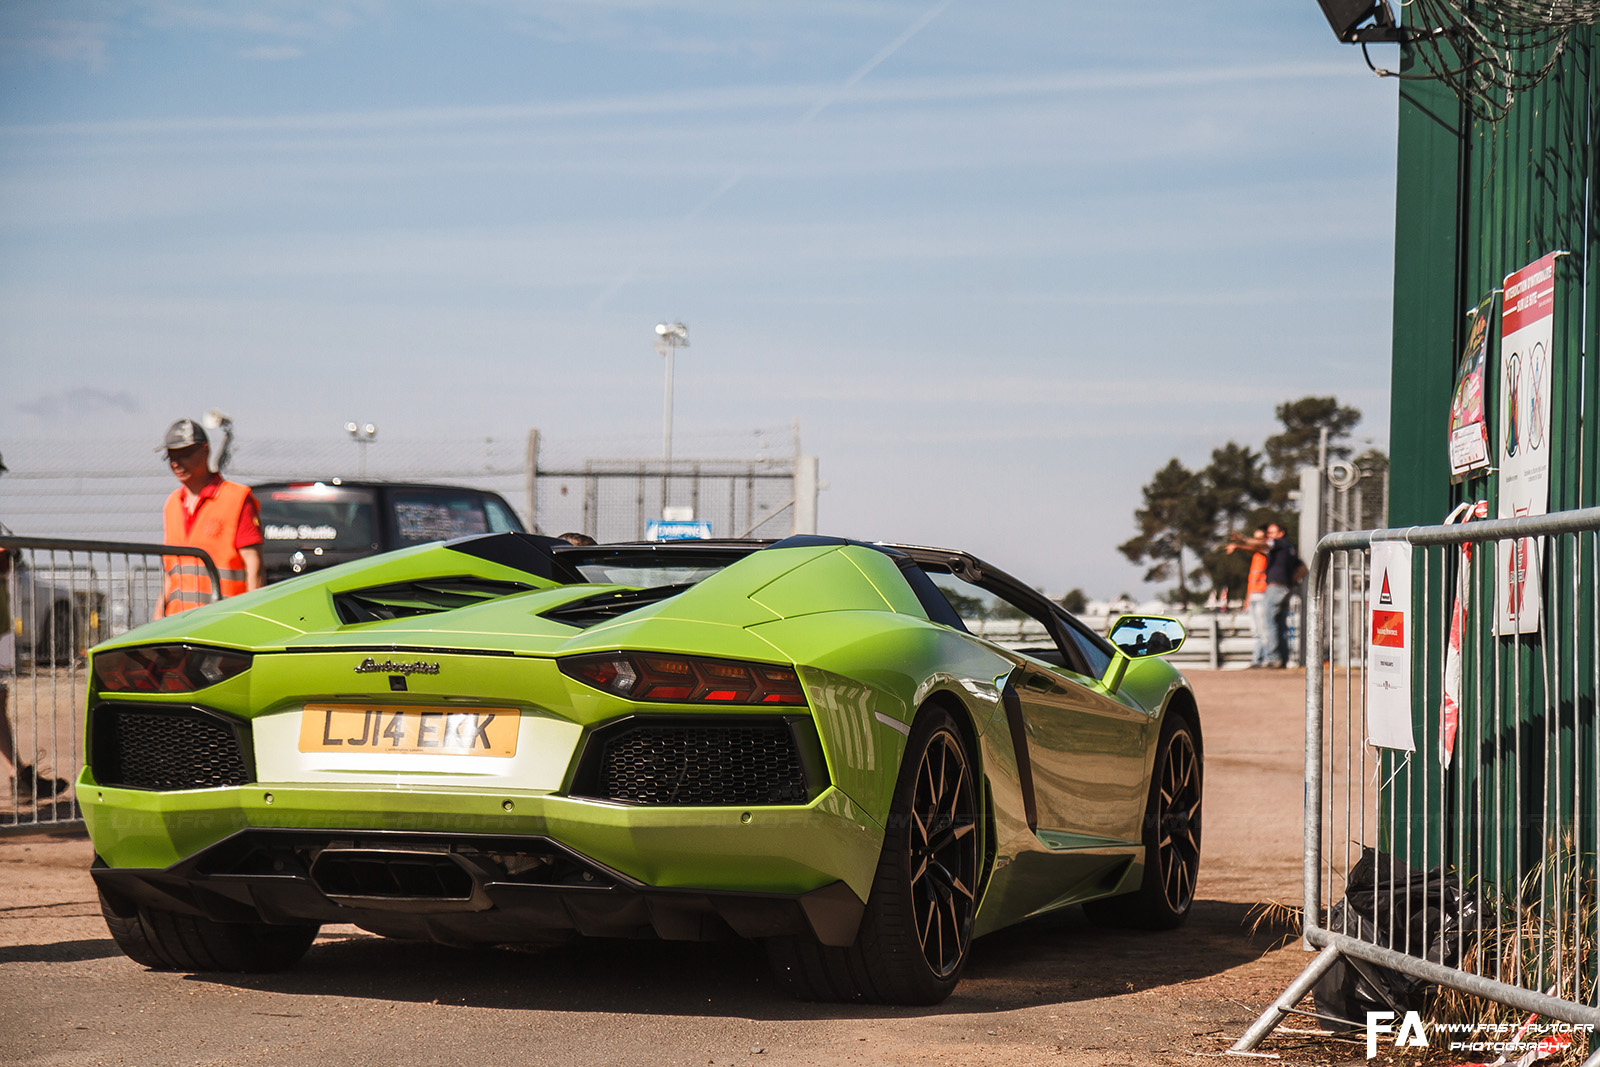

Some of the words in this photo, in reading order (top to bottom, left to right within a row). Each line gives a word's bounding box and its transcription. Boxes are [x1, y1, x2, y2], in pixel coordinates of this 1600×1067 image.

[264, 524, 298, 540] Media
[298, 524, 337, 540] Shuttle
[354, 657, 440, 675] Lamborghini
[323, 710, 405, 747] LJ14
